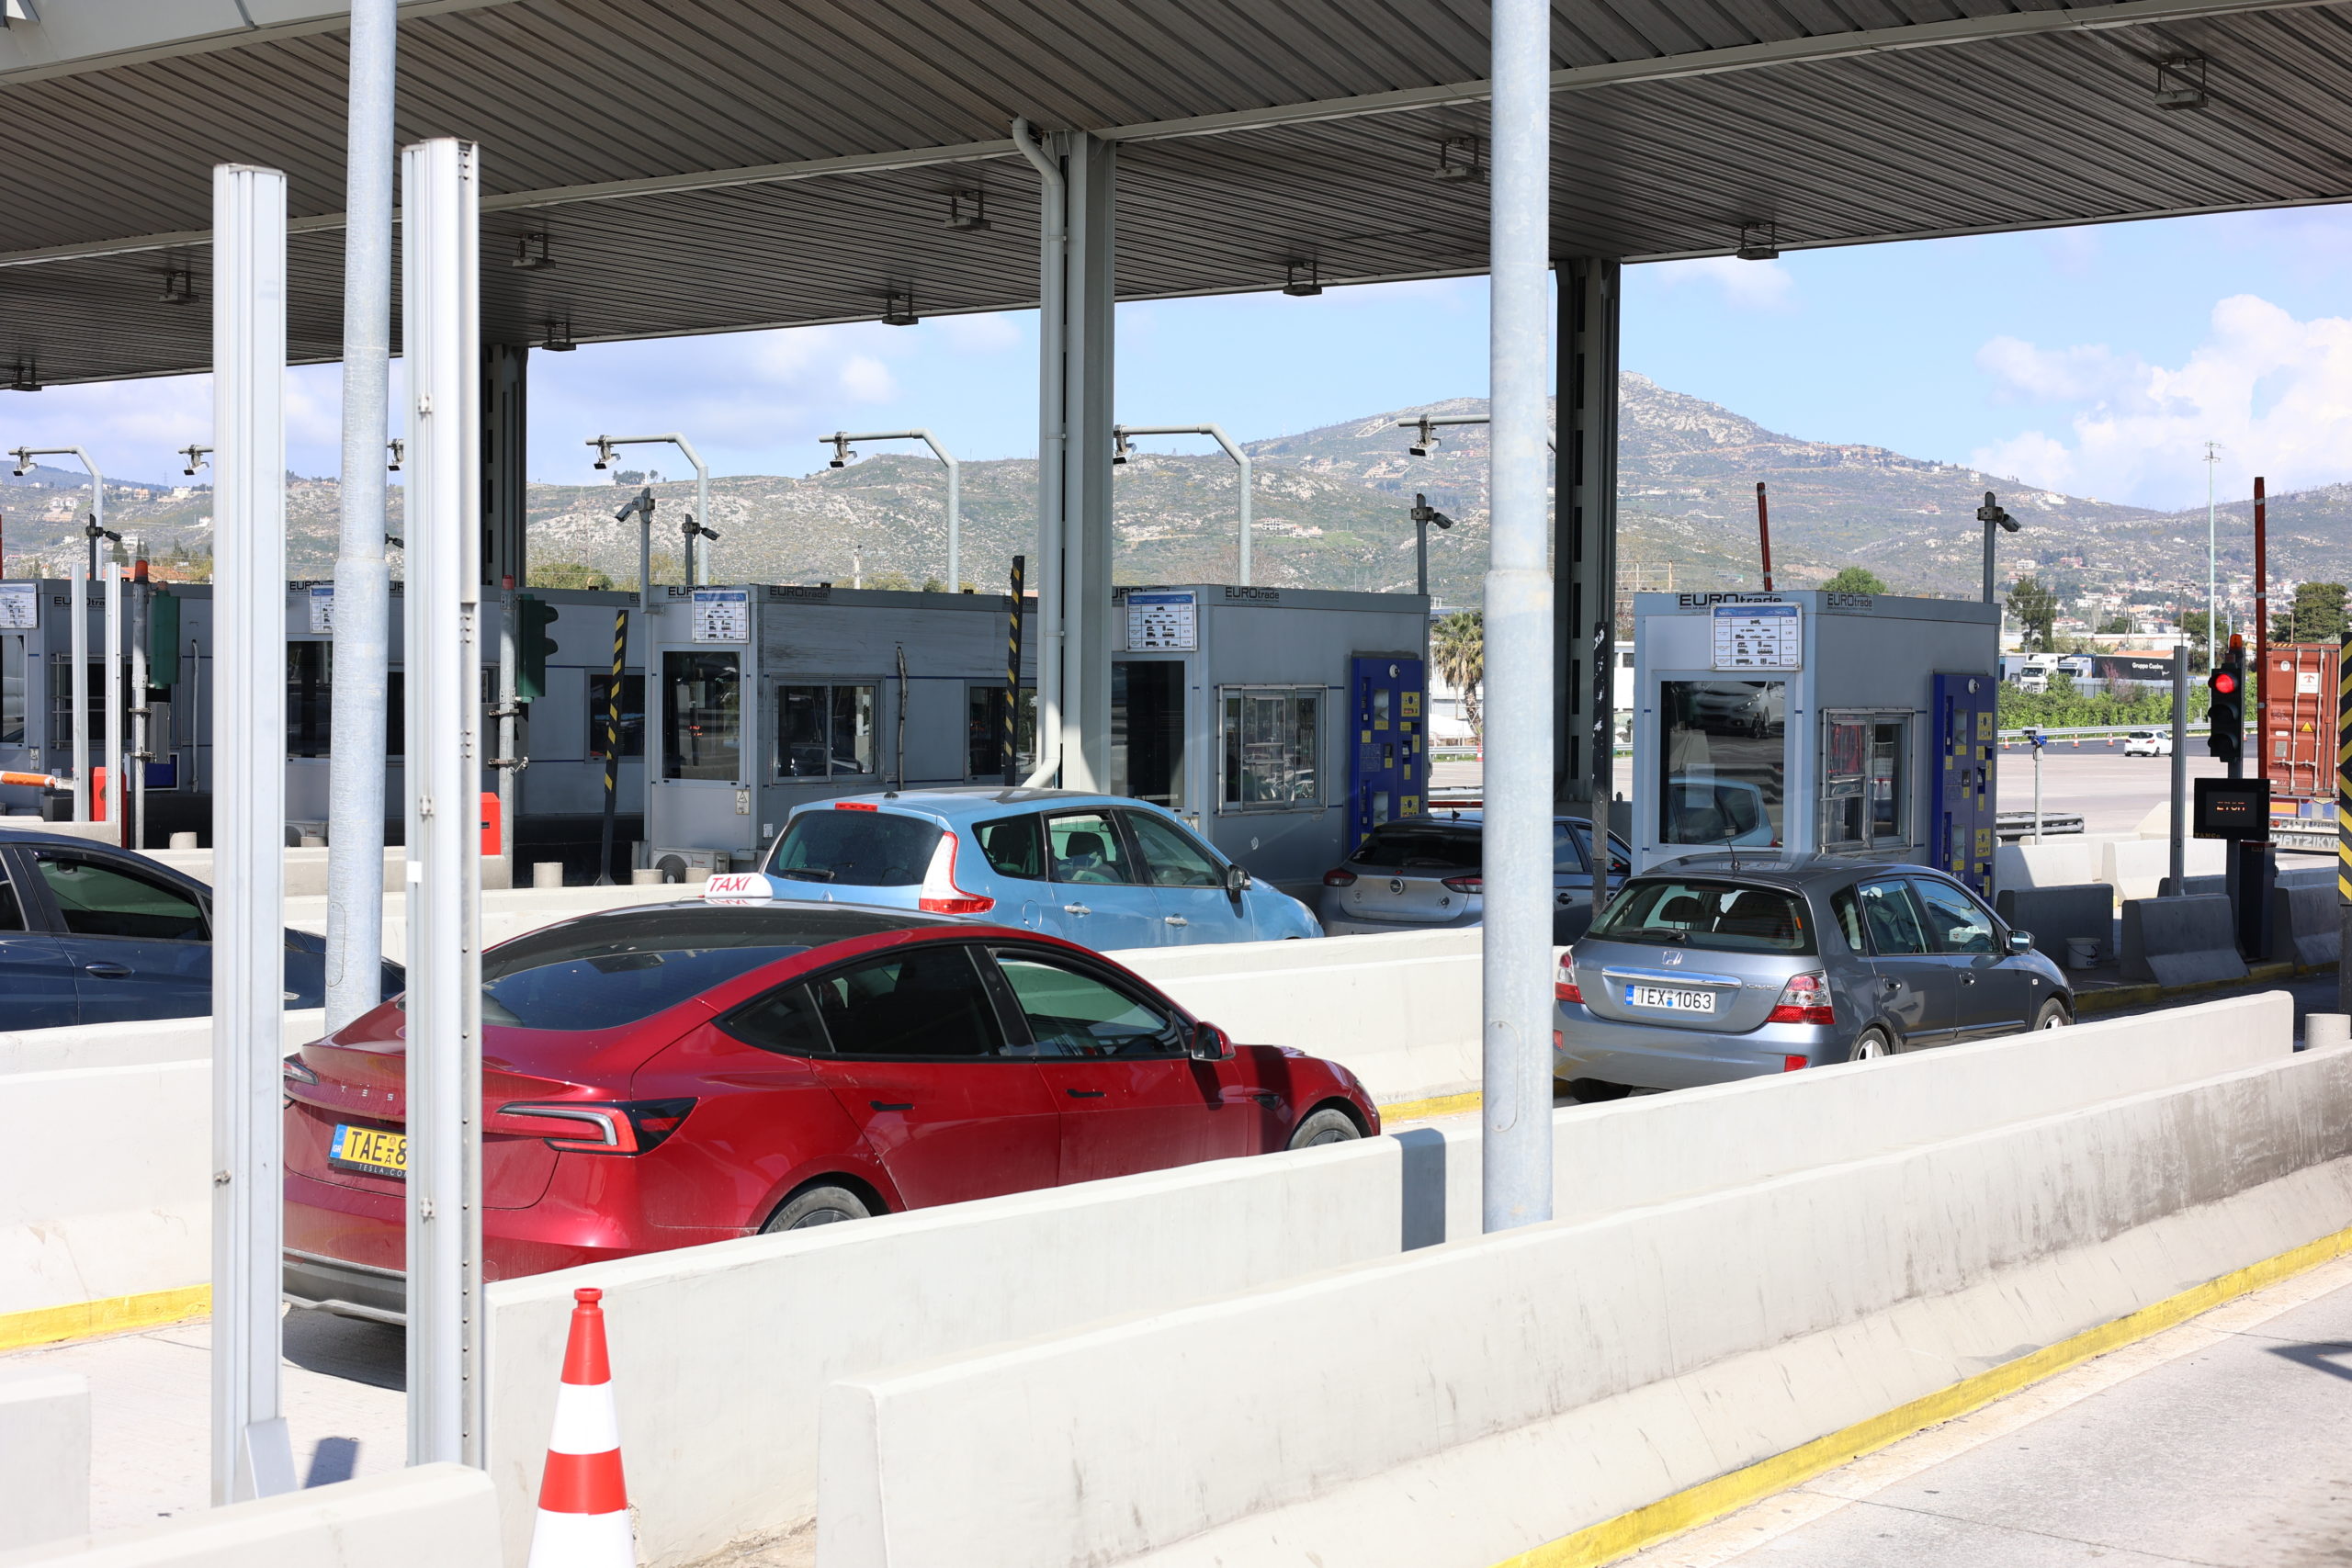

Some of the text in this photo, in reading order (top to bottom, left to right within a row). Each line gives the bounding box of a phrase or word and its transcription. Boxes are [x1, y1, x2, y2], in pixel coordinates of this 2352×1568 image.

[1225, 586, 1280, 599] EUROtrade
[1827, 592, 1872, 607] EUROtrade
[2269, 833, 2339, 848] HATZIKYR
[709, 876, 752, 892] TAXI
[340, 1085, 395, 1101] TES
[333, 1145, 342, 1154] GR
[358, 1163, 407, 1178] TESLA.CO
